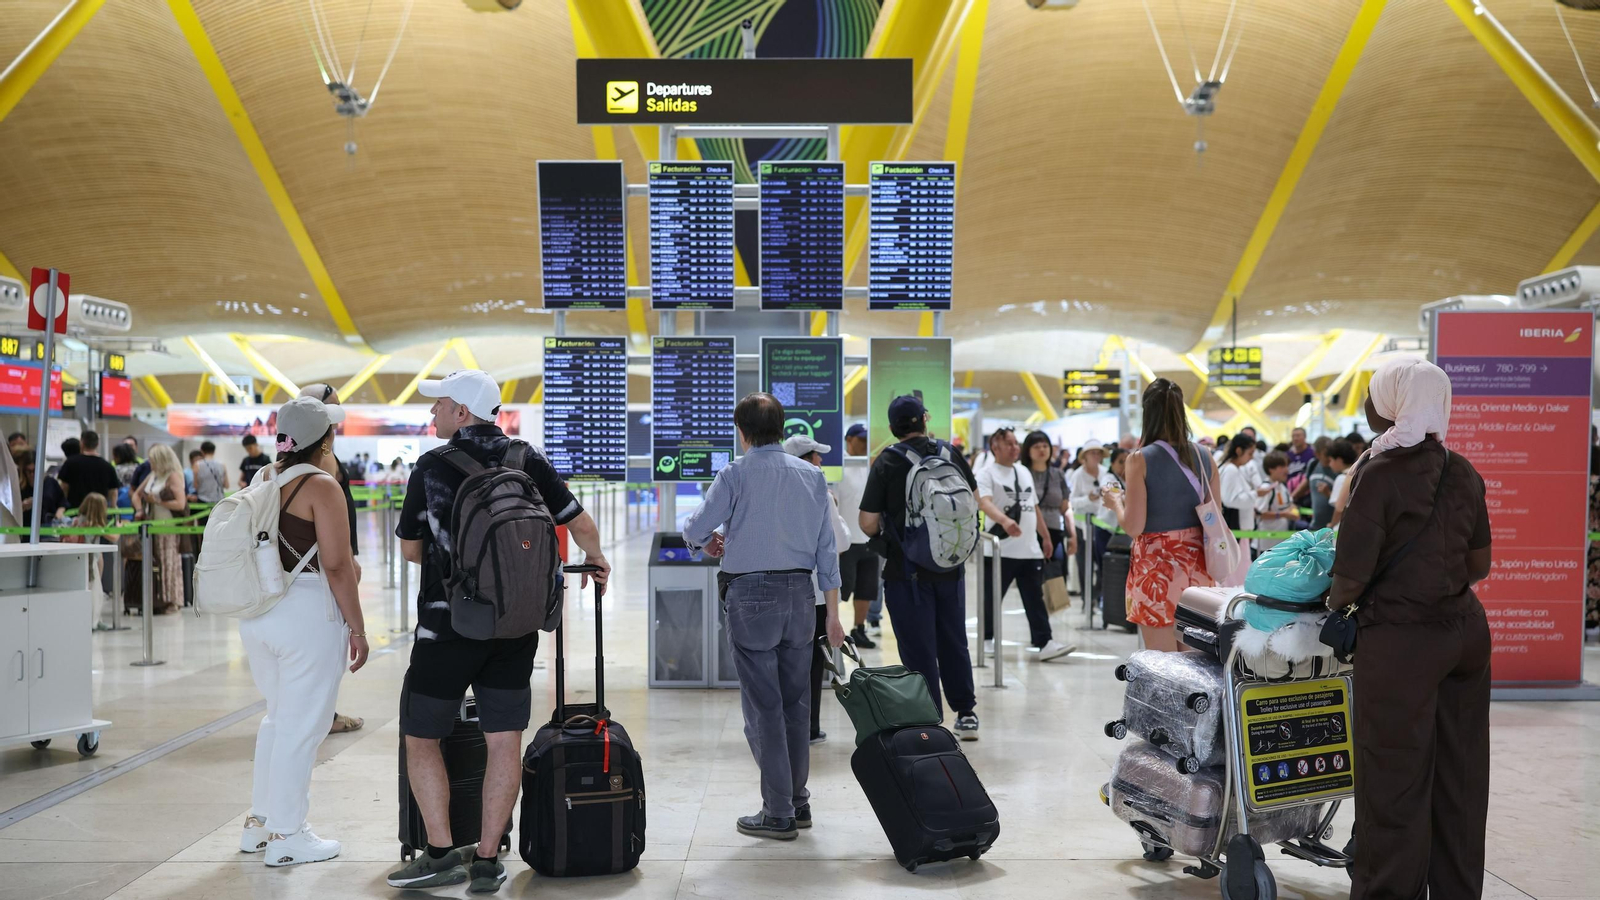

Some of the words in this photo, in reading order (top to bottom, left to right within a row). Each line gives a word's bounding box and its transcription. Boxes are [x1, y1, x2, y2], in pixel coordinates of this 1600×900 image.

[646, 82, 712, 98] Departures
[646, 98, 697, 112] Salidas
[1520, 328, 1564, 338] IBERIA
[1, 337, 18, 355] 887
[1445, 363, 1480, 373] Business
[1496, 364, 1513, 373] 780
[1520, 364, 1536, 373] 799
[1450, 403, 1478, 413] mérica,
[1481, 404, 1510, 412] Oriente
[1512, 404, 1537, 412] Medio
[1539, 405, 1544, 413] y
[1546, 403, 1569, 412] Dakar
[1448, 423, 1476, 432] merica,
[1478, 423, 1504, 431] Middle
[1506, 423, 1522, 431] East
[1523, 423, 1531, 432] &
[1533, 423, 1556, 432] Dakar
[1466, 442, 1483, 450] 829
[1485, 480, 1502, 488] frica
[1500, 559, 1523, 569] Japón
[1525, 561, 1530, 569] y
[1531, 560, 1553, 568] Reino
[1555, 560, 1577, 568] Unido
[1532, 573, 1567, 582] Kingdom
[1506, 620, 1554, 629] accesibilidad
[1493, 633, 1504, 642] for
[1506, 634, 1545, 642] customers
[1546, 633, 1563, 641] with
[1314, 692, 1334, 700] pasajeros
